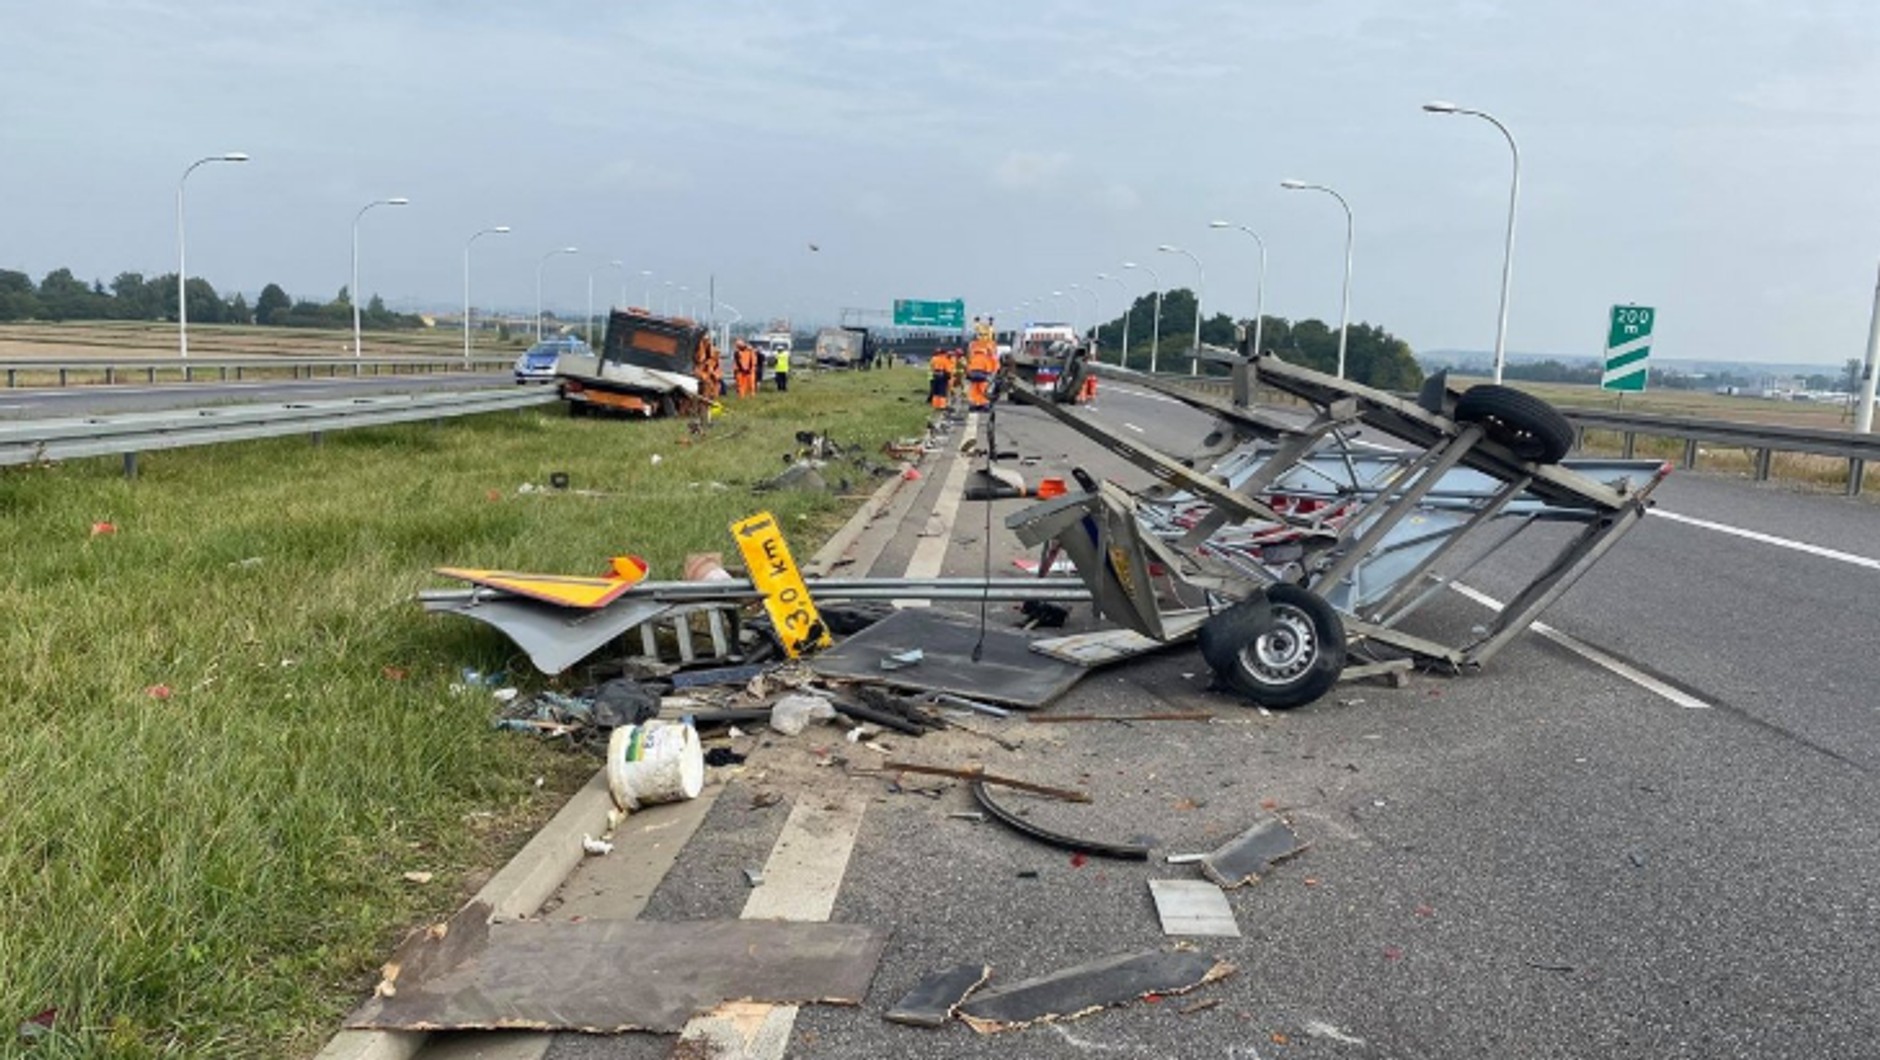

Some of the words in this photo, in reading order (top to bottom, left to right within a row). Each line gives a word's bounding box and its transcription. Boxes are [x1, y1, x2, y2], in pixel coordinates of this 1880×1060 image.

[1617, 309, 1649, 324] 200
[1624, 325, 1638, 334] m
[762, 538, 788, 577] km
[779, 588, 810, 630] 3,0
